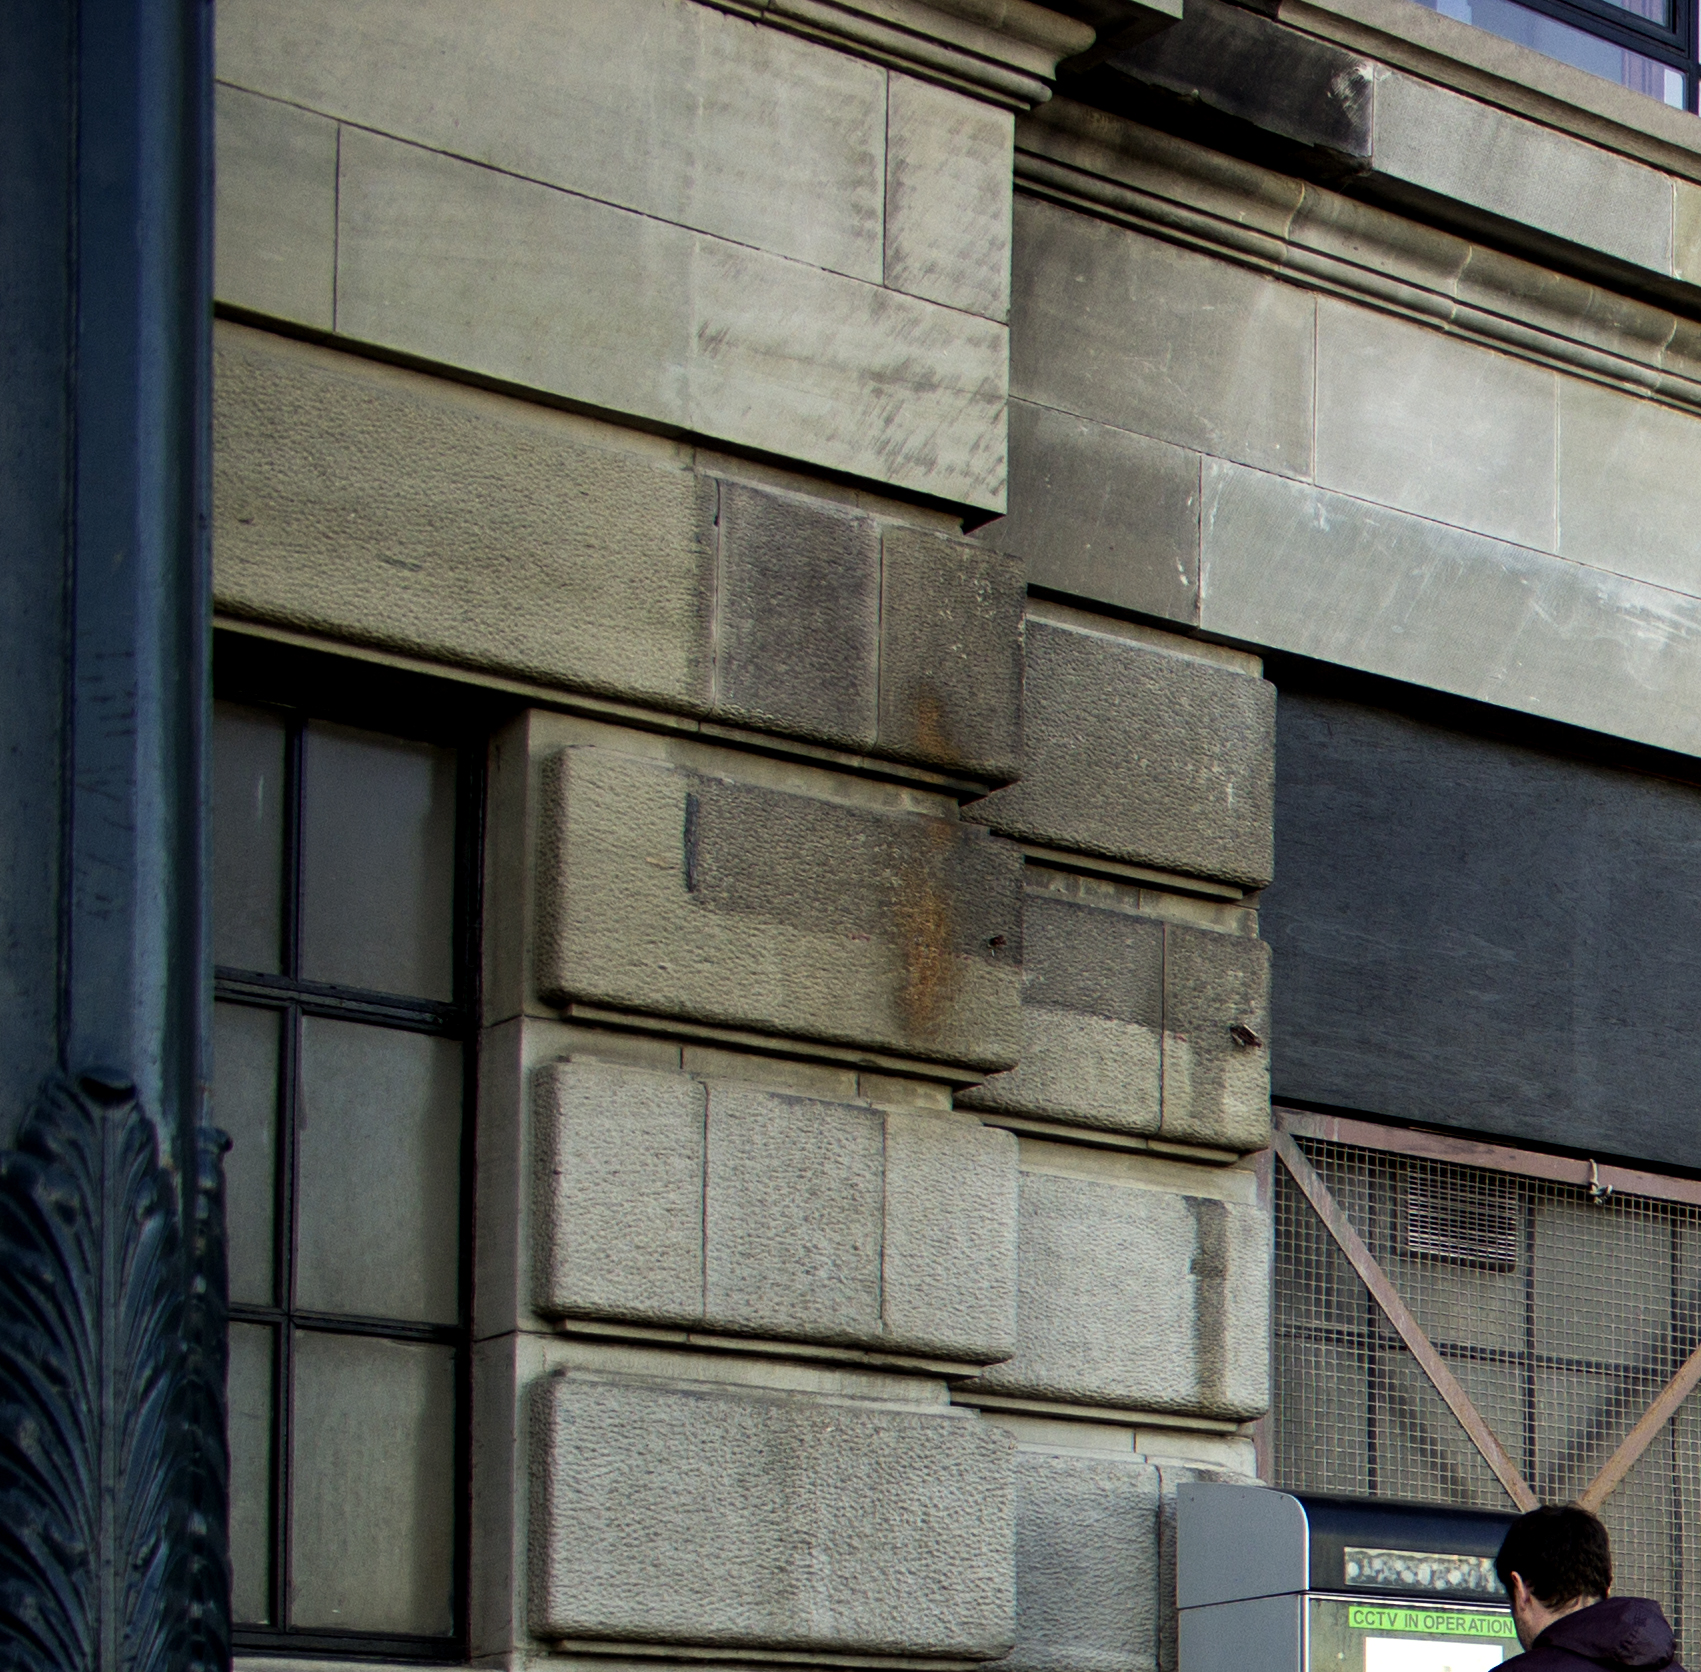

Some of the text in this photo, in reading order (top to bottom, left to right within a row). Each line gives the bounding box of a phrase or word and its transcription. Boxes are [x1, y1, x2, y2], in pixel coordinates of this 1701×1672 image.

[1353, 1610, 1513, 1635] CCTV IN OPERATION
